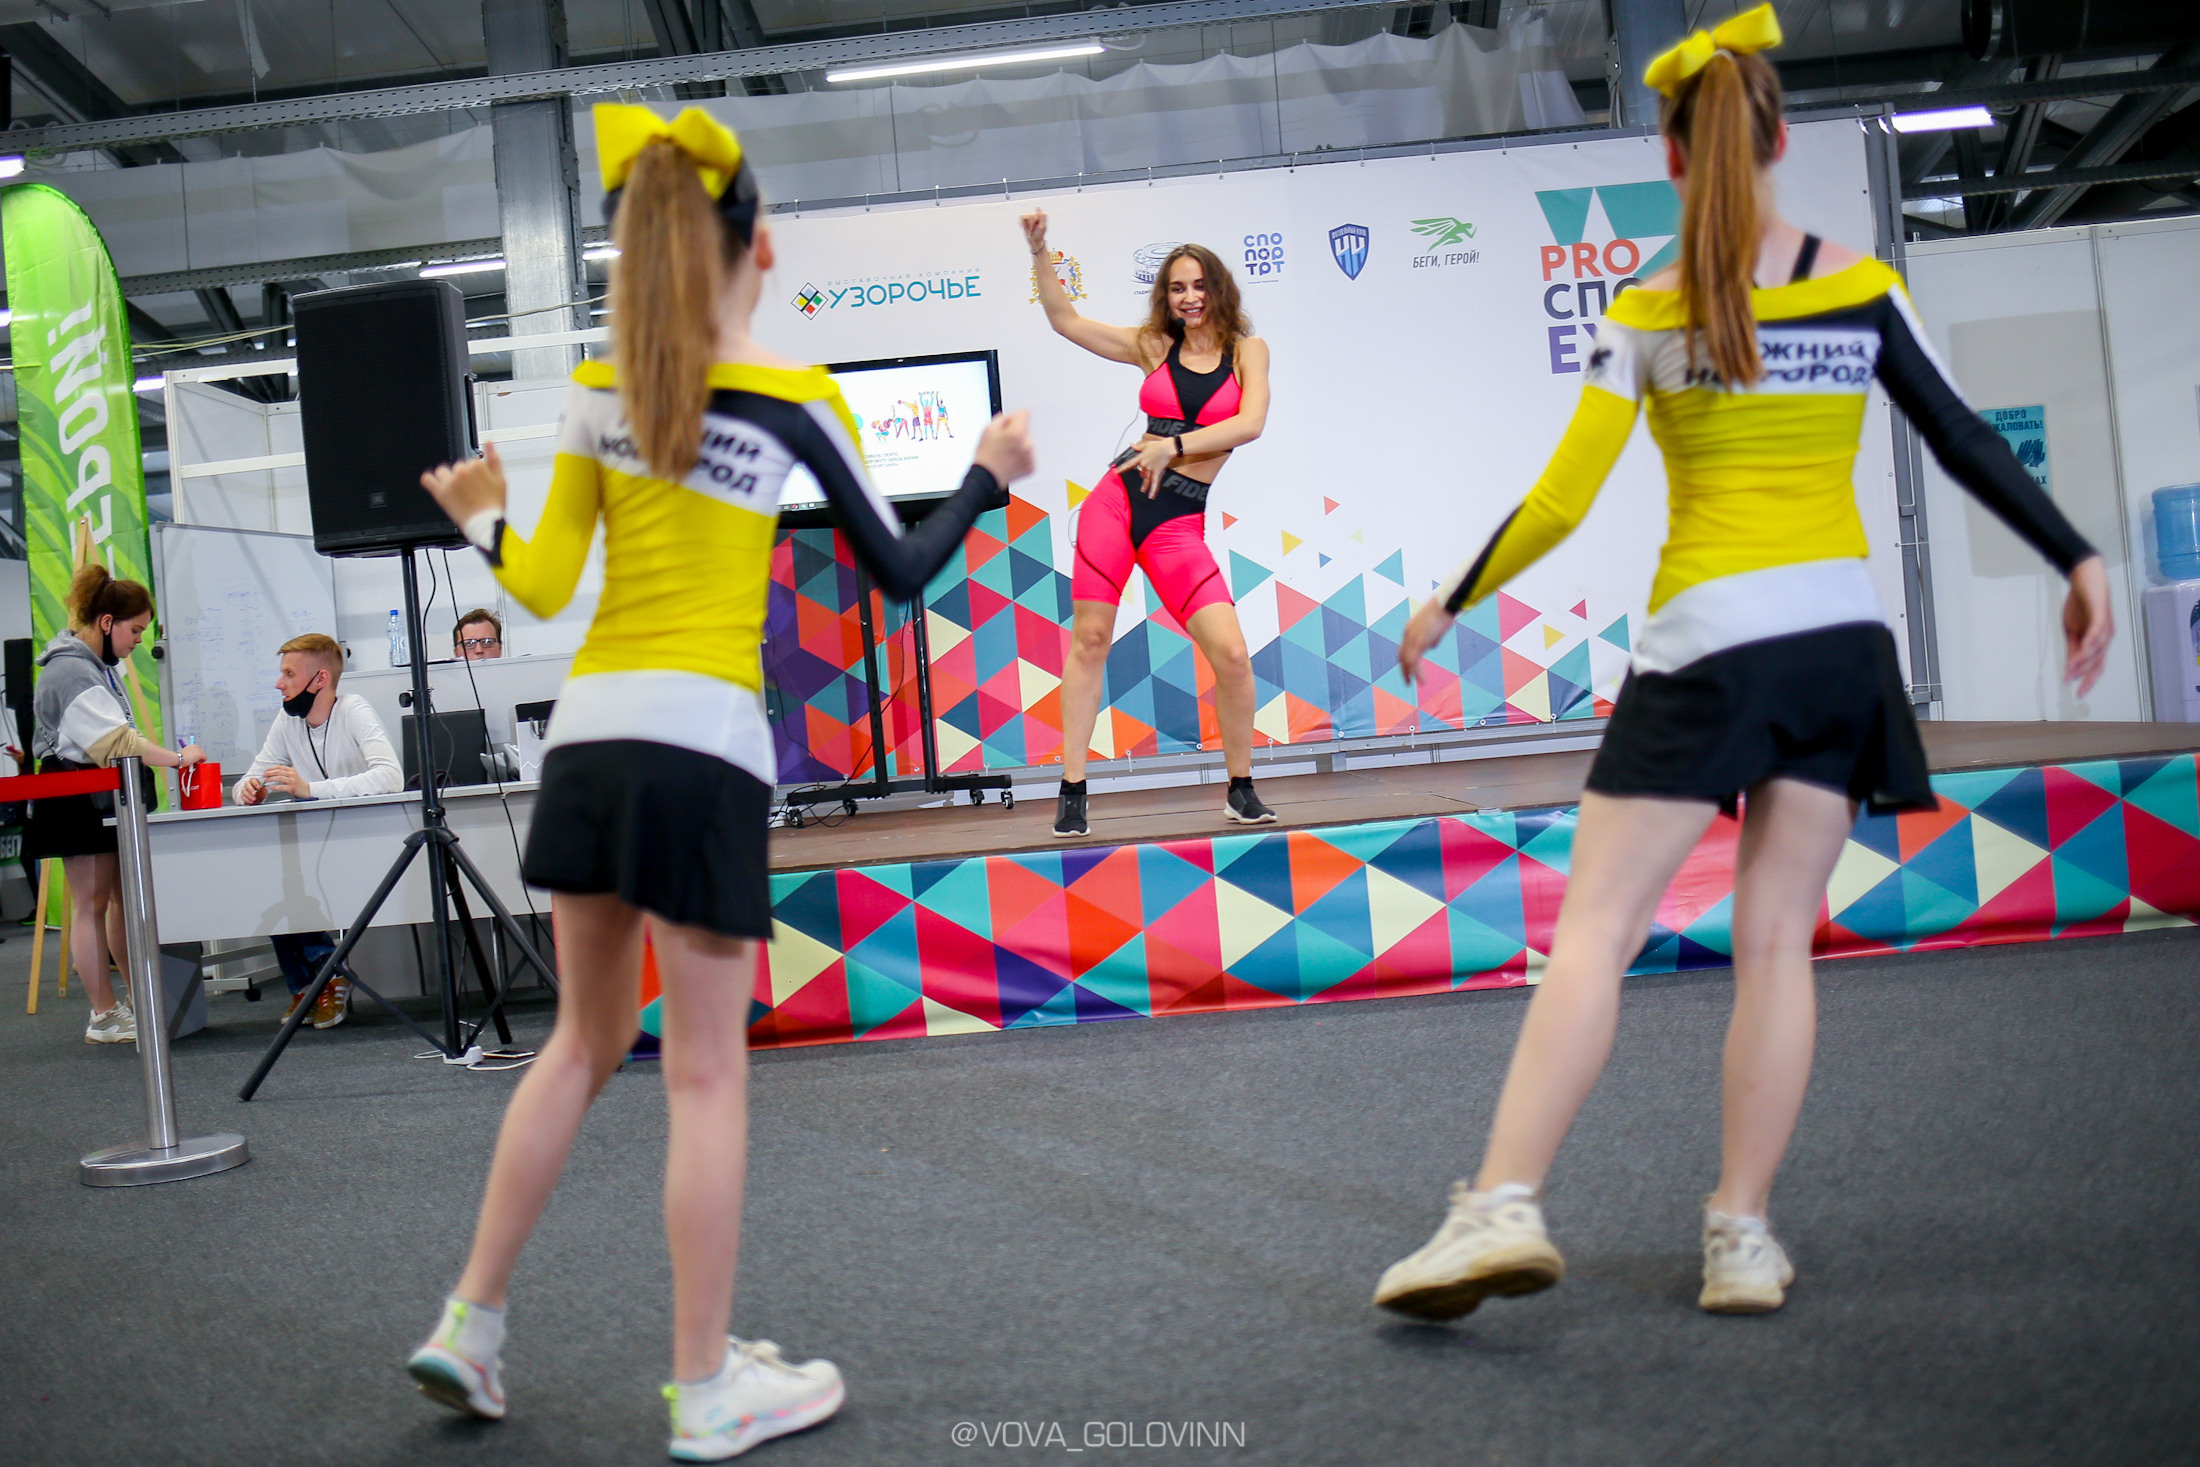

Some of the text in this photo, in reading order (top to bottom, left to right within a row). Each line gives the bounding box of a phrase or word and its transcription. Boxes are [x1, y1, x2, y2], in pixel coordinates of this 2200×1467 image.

[1412, 249, 1480, 268] БЕГИ, ГЕРОЙ!
[1540, 238, 1640, 281] PRO
[827, 267, 981, 287] ВЫСТАВОЧНАЯ КОМПАНИЯ
[828, 275, 982, 309] УЗОРОЧЬЕ
[1995, 410, 2027, 423] ДОБРО
